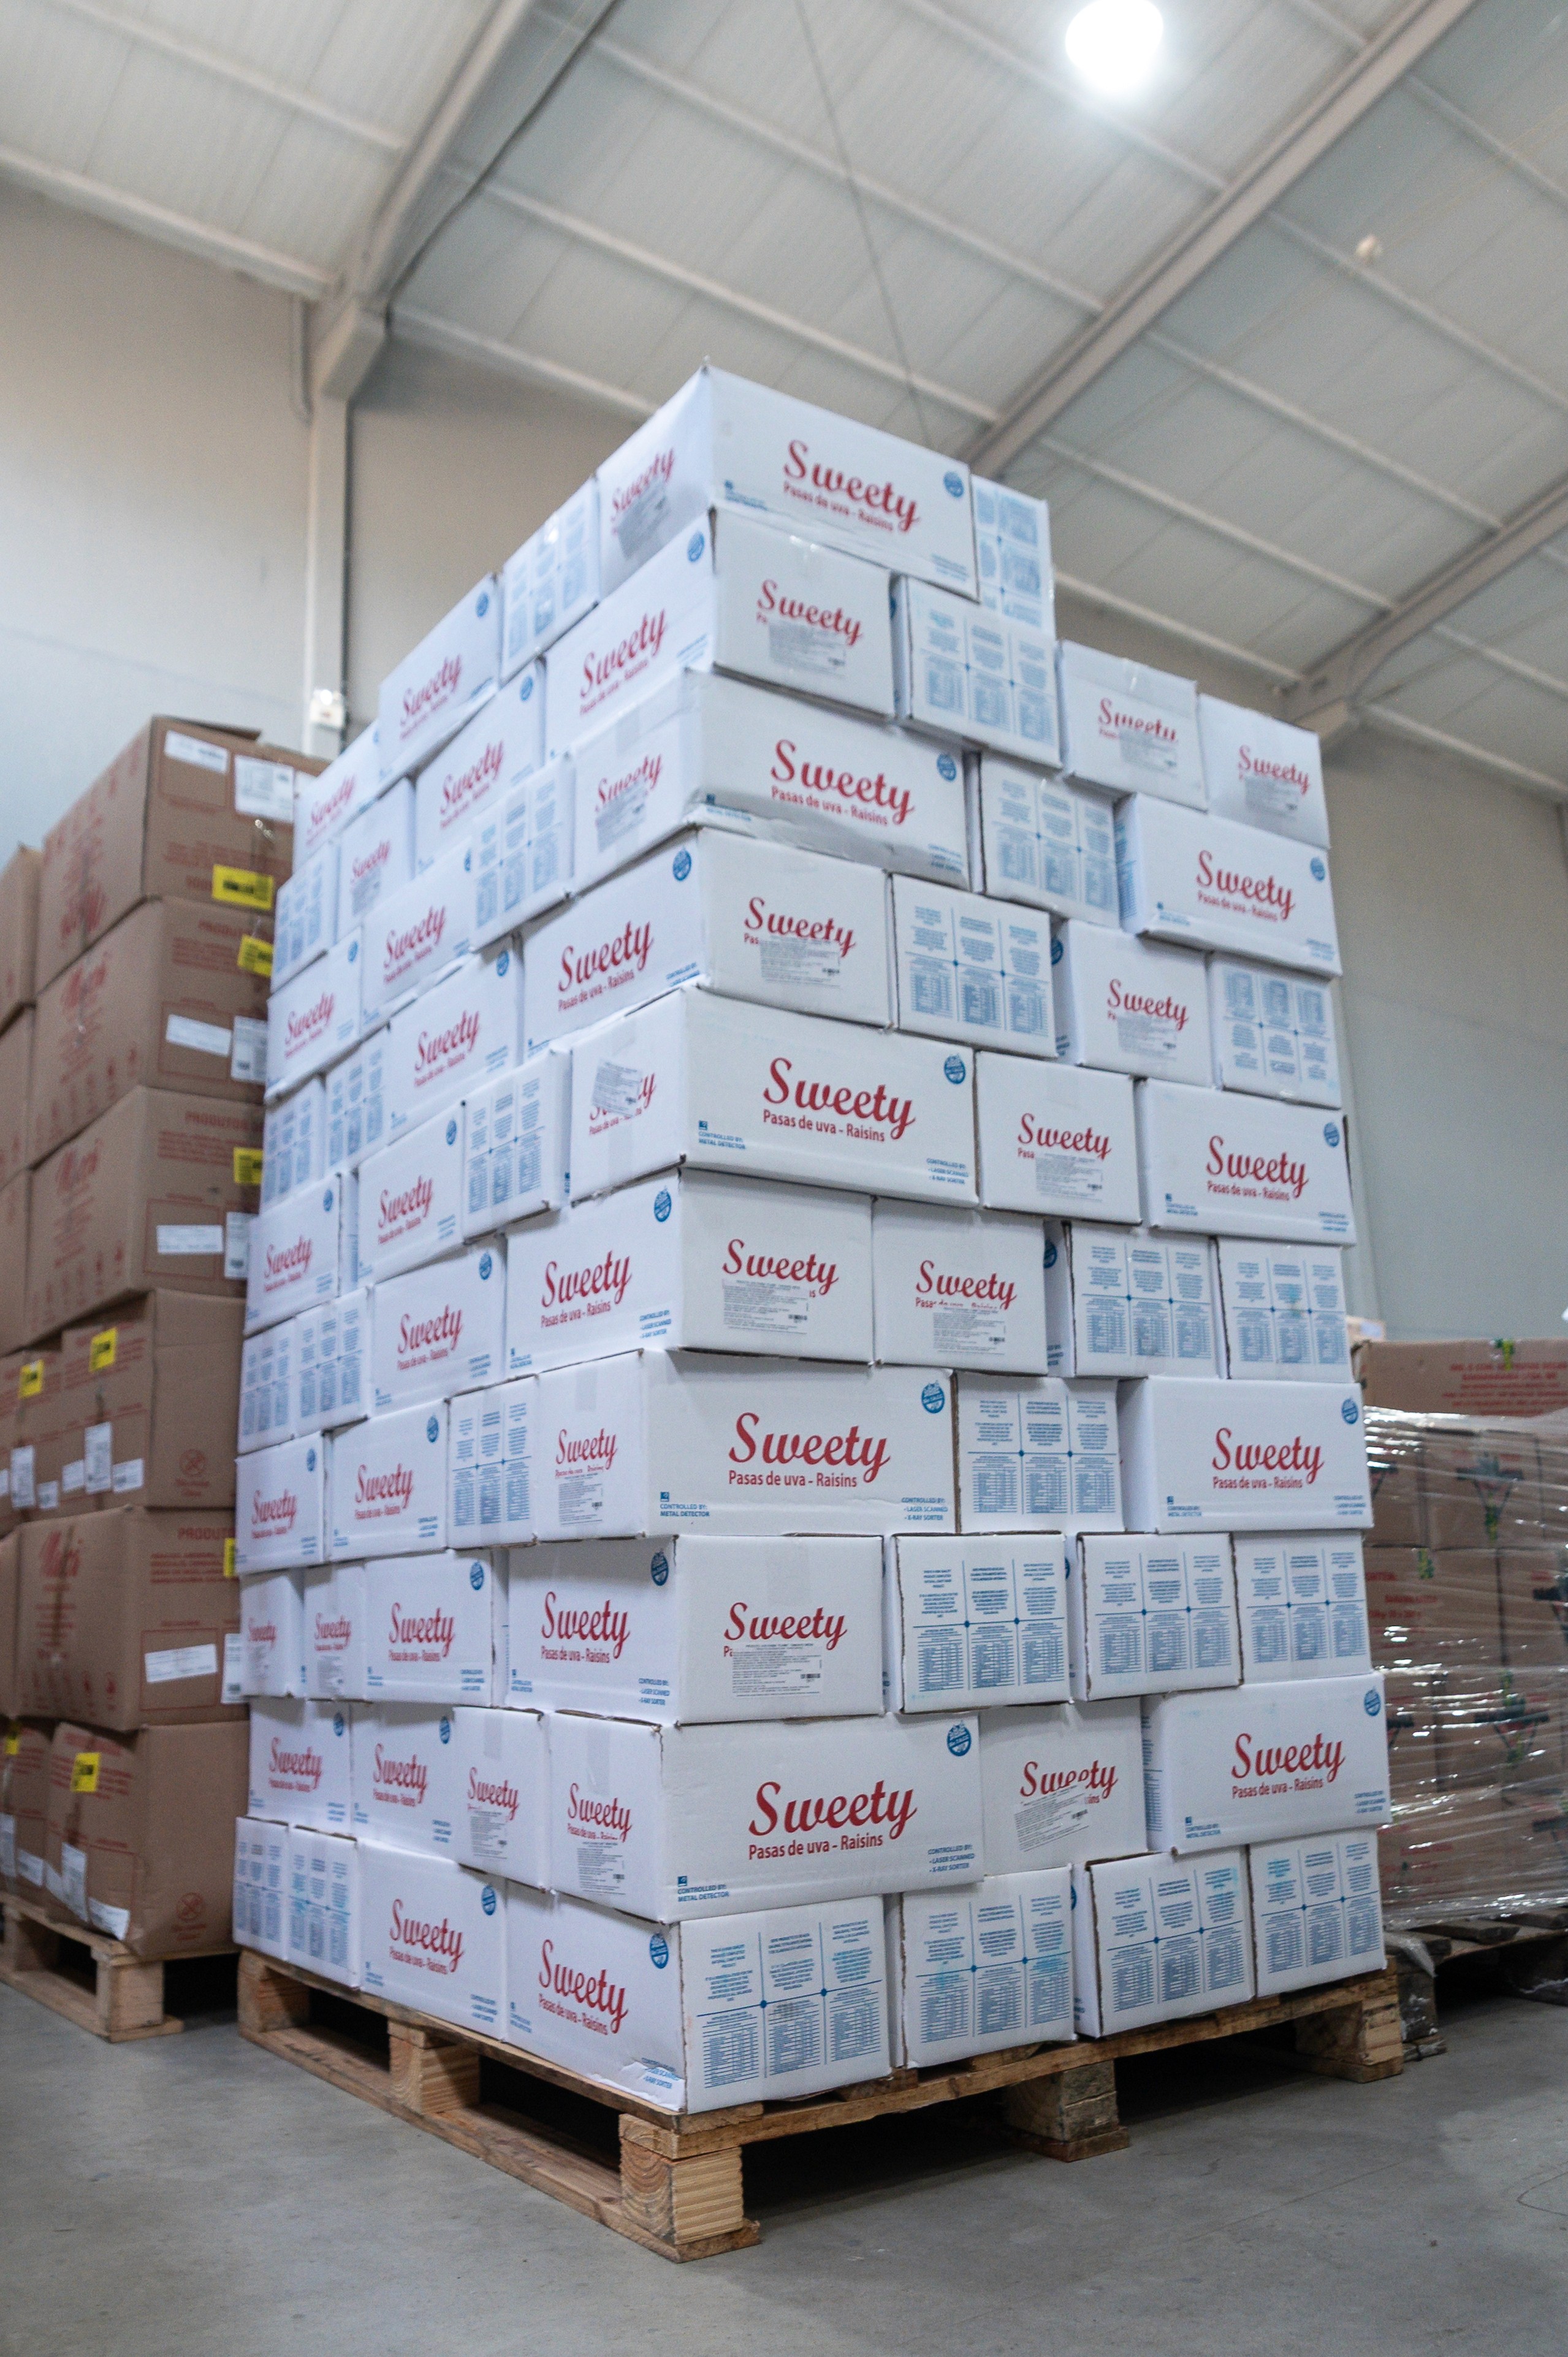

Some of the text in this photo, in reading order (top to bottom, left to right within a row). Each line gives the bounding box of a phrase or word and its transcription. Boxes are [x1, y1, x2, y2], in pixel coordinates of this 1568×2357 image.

[783, 440, 919, 534] Sweety
[756, 580, 862, 647] Sweety
[580, 611, 665, 698] Sweety
[440, 739, 503, 814] Sweety
[770, 739, 913, 826] Sweety
[1238, 745, 1309, 796] Sweety
[771, 786, 887, 826] Pasas de uva Raisins
[1195, 850, 1295, 921] Sweety
[383, 907, 446, 969] Sweety
[744, 897, 854, 958] Sweety
[558, 921, 653, 993] Sweety
[284, 992, 334, 1046] Sweety
[1106, 979, 1189, 1032] Sweety
[414, 1011, 480, 1072] Sweety
[763, 1057, 915, 1140] Sweety
[763, 1109, 796, 1127] Pasas
[798, 1115, 812, 1130] de
[816, 1121, 835, 1134] uva
[847, 1122, 885, 1141] Raisins
[1017, 1113, 1112, 1160] Sweety
[1205, 1135, 1309, 1199] Sweety
[378, 1176, 433, 1230] Sweety
[264, 1236, 312, 1278] Sweety
[541, 1250, 631, 1309] Sweety
[721, 1238, 839, 1295] Sweety
[915, 1260, 1017, 1311] Sweety
[397, 1304, 463, 1355] Sweety
[541, 1314, 558, 1327] Pasas
[587, 1301, 611, 1316] Raisins
[555, 1428, 617, 1470] Sweety
[728, 1411, 890, 1483] Sweety
[1211, 1427, 1324, 1485] Sweety
[354, 1463, 414, 1509] Sweety
[729, 1470, 763, 1485] Pasas
[766, 1471, 780, 1486] de
[784, 1475, 805, 1487] uva
[816, 1472, 857, 1488] Raisins
[1213, 1476, 1237, 1488] Pasas
[1274, 1476, 1302, 1488] Raisins
[388, 1602, 455, 1658] Sweety
[541, 1591, 630, 1660] Sweety
[724, 1602, 848, 1650] Sweety
[541, 1645, 558, 1660] Pasas
[586, 1648, 609, 1663] Raisins
[269, 1737, 323, 1790] Sweety
[373, 1743, 428, 1805] Sweety
[1231, 1732, 1345, 1784] Sweety
[467, 1767, 519, 1823] Sweety
[567, 1783, 633, 1843] Sweety
[748, 1780, 917, 1840] Sweety
[1232, 1786, 1257, 1799] Pasas
[1258, 1782, 1269, 1795] de
[1272, 1783, 1287, 1794] uva
[1294, 1776, 1323, 1791] Raisins
[749, 1845, 785, 1860] Pasas
[788, 1840, 803, 1856] de
[807, 1840, 829, 1854] uva
[840, 1833, 883, 1850] Raisins
[927, 1845, 963, 1854] CONTROLLED
[677, 1885, 716, 1894] CONTROLLED
[699, 1891, 729, 1900] DETECTOR
[389, 1898, 465, 1974] Sweety
[538, 1938, 629, 2035] Sweety
